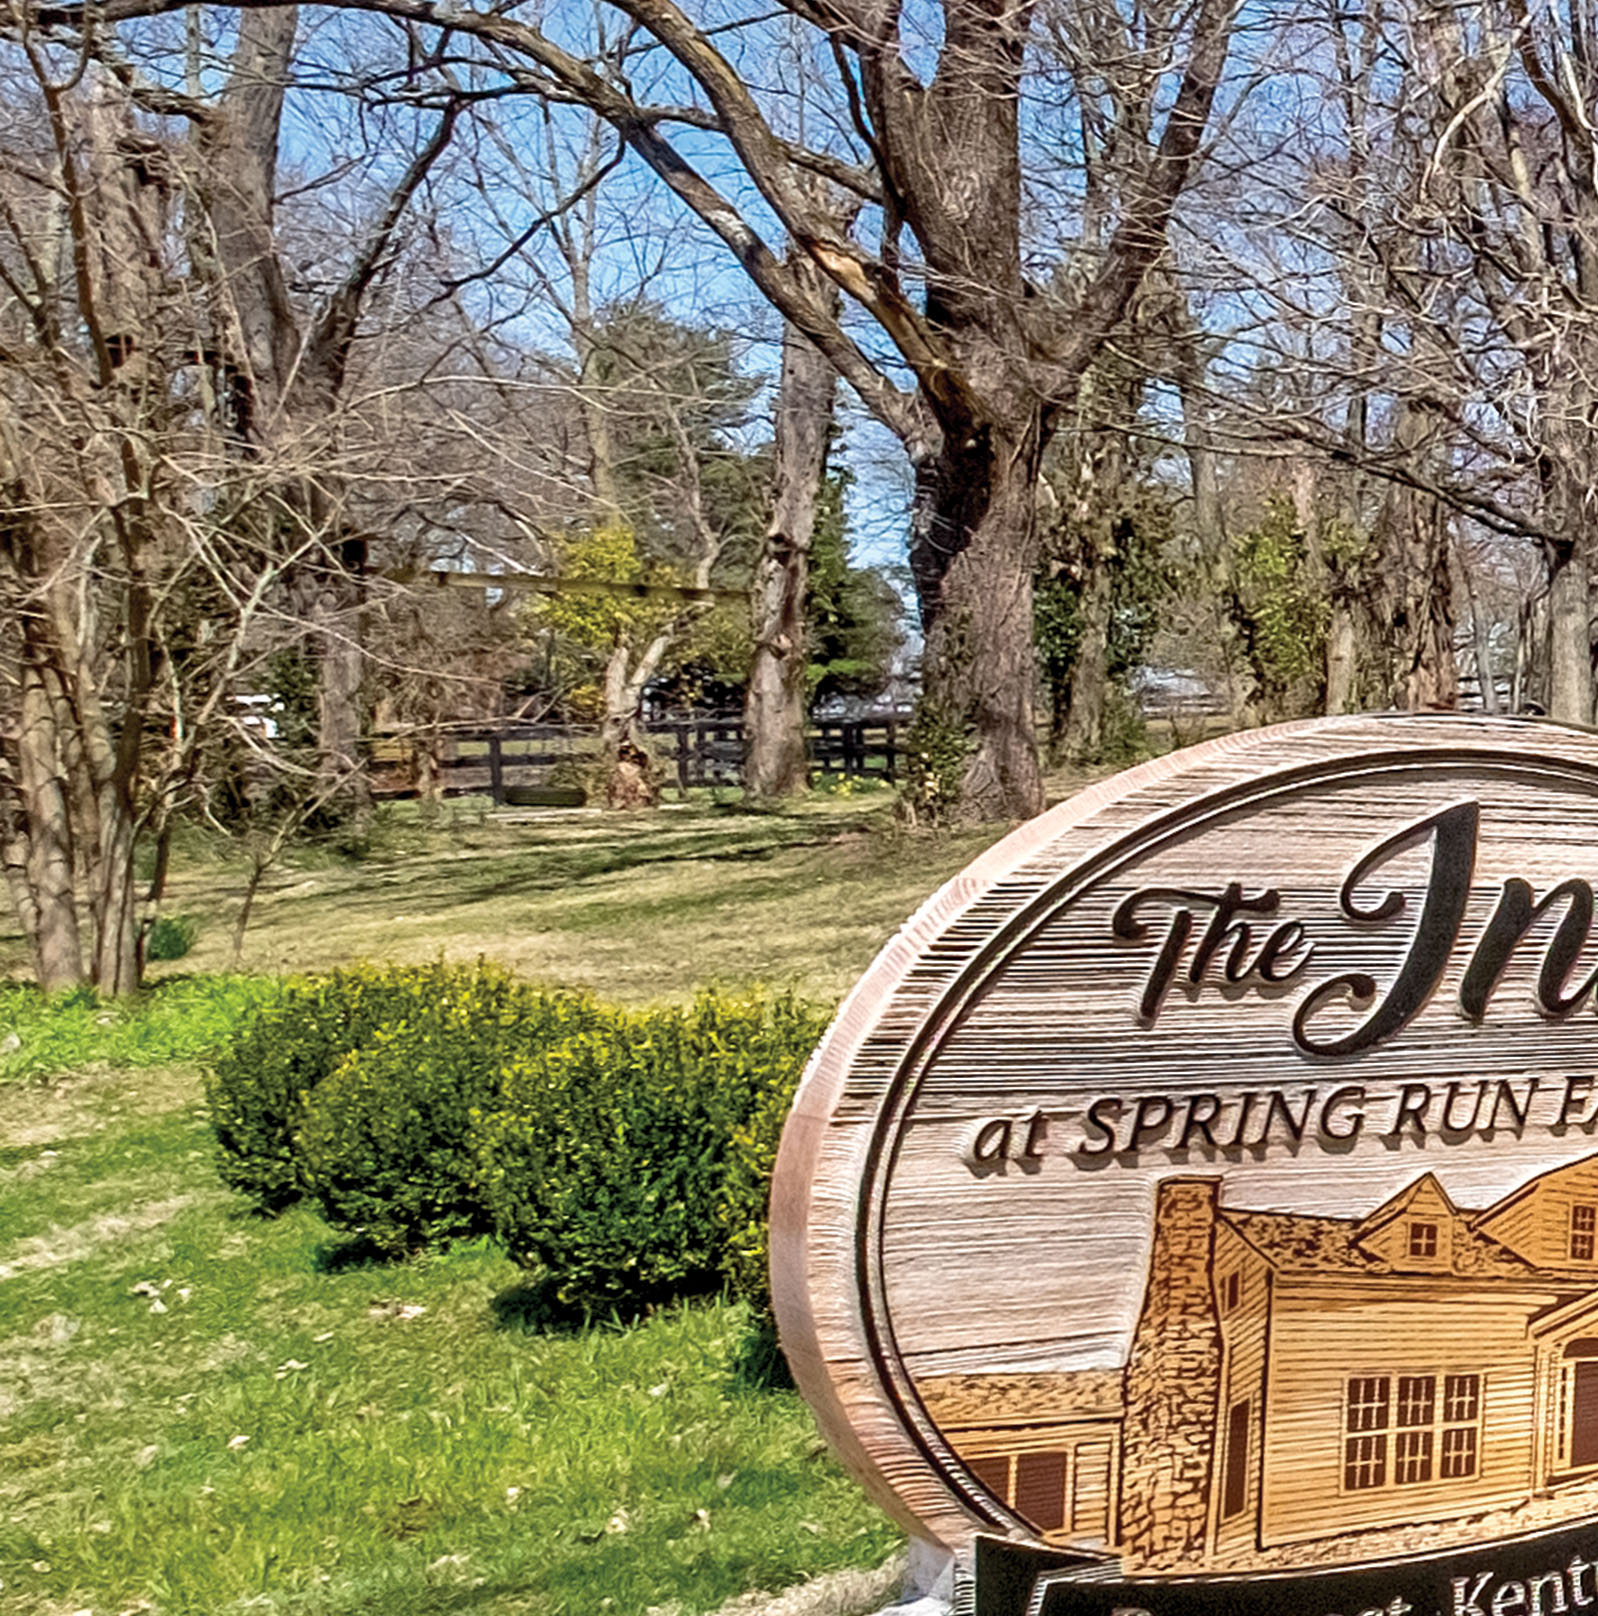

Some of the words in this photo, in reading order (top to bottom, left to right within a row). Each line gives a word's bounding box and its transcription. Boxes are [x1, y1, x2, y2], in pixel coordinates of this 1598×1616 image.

[1111, 882, 1314, 1028] The
[973, 1110, 1048, 1164] at
[1079, 1085, 1367, 1160] SPRING
[1397, 1077, 1540, 1136] RUN
